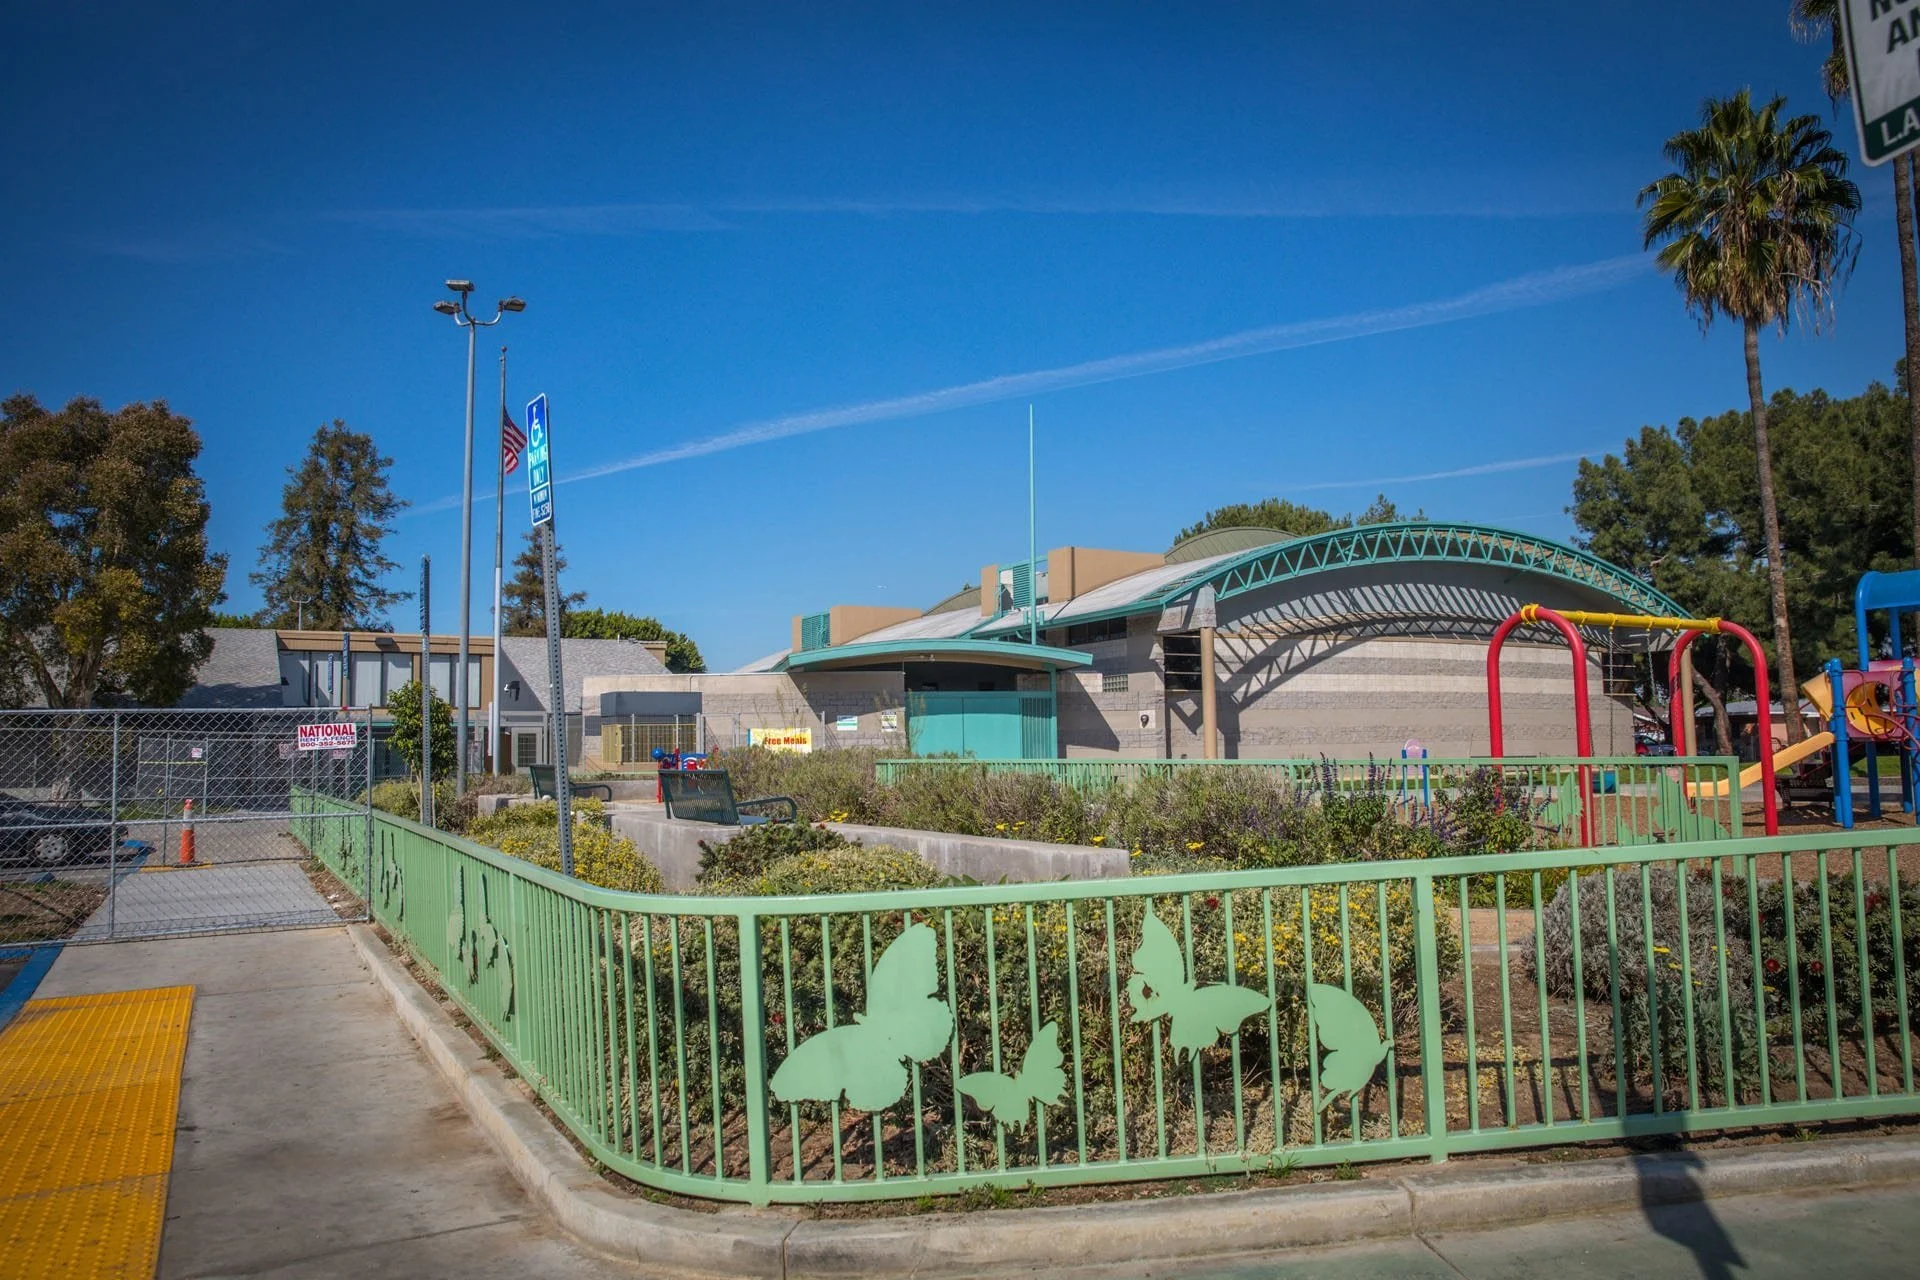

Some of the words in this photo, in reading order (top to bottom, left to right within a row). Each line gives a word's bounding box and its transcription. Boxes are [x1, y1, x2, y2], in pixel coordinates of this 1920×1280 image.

[300, 724, 355, 737] NATIONAL
[764, 736, 782, 745] Free
[783, 736, 807, 745] Meals
